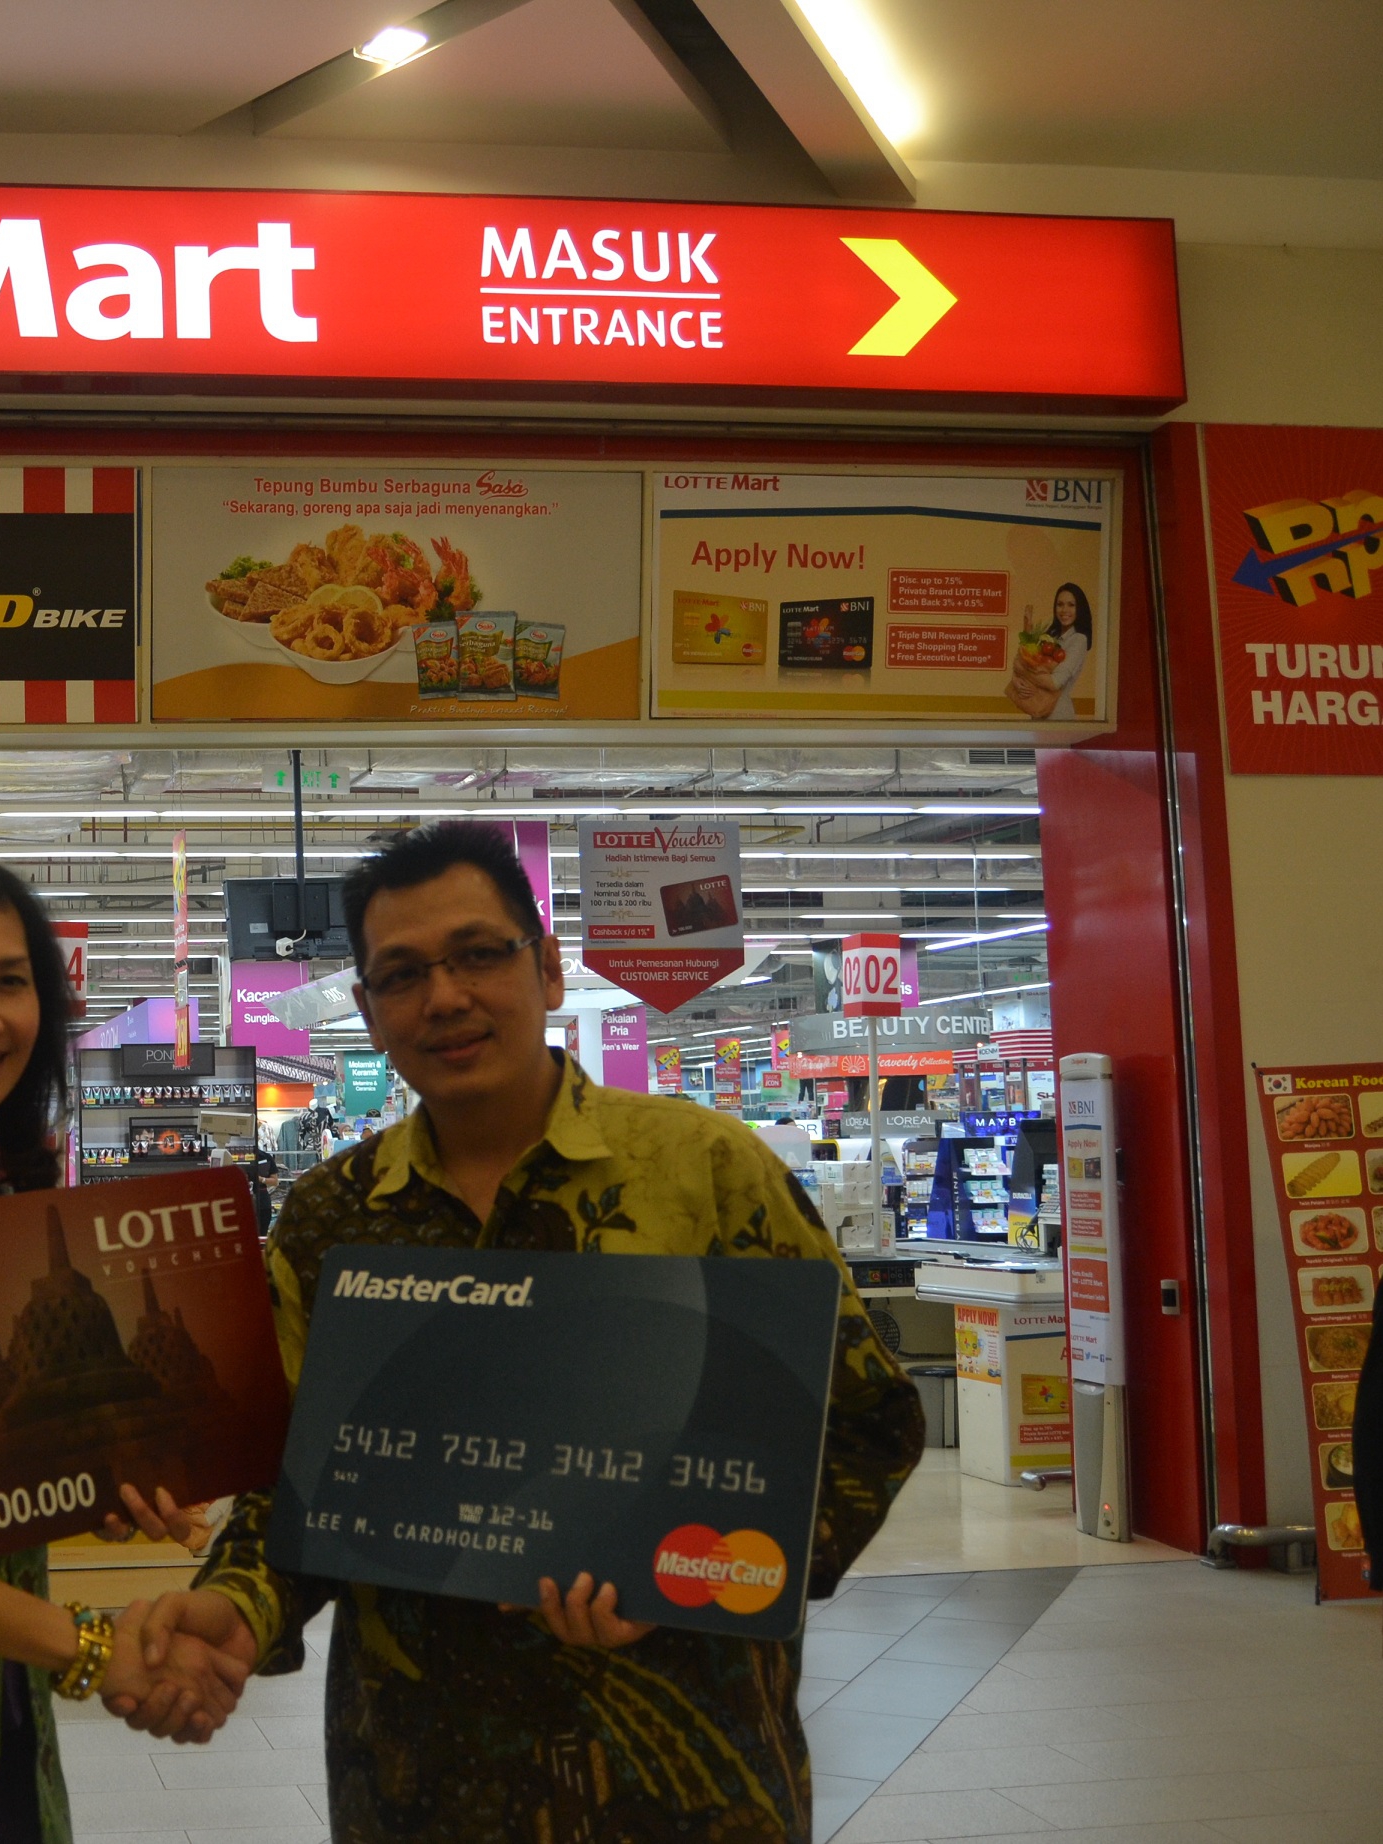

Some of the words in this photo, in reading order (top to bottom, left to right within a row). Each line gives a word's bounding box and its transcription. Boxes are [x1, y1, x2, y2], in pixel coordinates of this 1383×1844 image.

[481, 226, 720, 284] MASUK
[481, 305, 724, 350] ENTRANCE
[254, 477, 314, 497] Tepung
[319, 478, 378, 494] Bumbu
[383, 478, 471, 497] Serbaguna
[664, 476, 728, 490] LOTTE
[731, 475, 780, 491] Mart
[1052, 480, 1103, 503] BNI
[303, 503, 352, 517] goreng
[355, 504, 381, 516] apa
[384, 502, 413, 517] saja
[415, 502, 442, 517] jadi
[691, 541, 778, 573] Apply
[787, 543, 866, 570] Now!
[33, 609, 127, 628] BIKE
[1251, 690, 1383, 725] HARG
[595, 835, 652, 848] LOTTE
[654, 825, 724, 854] Voucher
[605, 854, 633, 863] Hadiah
[671, 855, 689, 864] Bagi
[690, 855, 716, 863] Semua
[609, 960, 635, 968] Untuk
[636, 960, 684, 969] Pemesanan
[685, 960, 720, 970] Hubungi
[620, 971, 670, 982] CUSTOMER
[671, 971, 710, 981] SERVICE
[844, 956, 861, 996] 02
[865, 954, 899, 995] 02
[610, 1026, 629, 1036] Pria
[833, 1016, 930, 1039] BEAUTY
[621, 1043, 640, 1051] Wear
[1294, 1076, 1350, 1090] Korean
[1077, 1101, 1095, 1115] BNI
[93, 1197, 240, 1254] LOTTE
[101, 1242, 245, 1277] VOUCHER
[333, 1269, 533, 1307] MasterCard
[333, 1423, 418, 1461] 5412
[441, 1433, 527, 1472] 7512
[550, 1443, 644, 1484] 3412
[668, 1453, 767, 1495] 3456
[306, 1511, 342, 1533] LEE
[393, 1521, 527, 1556] CARDHOLDER
[654, 1550, 783, 1590] MasterCard
